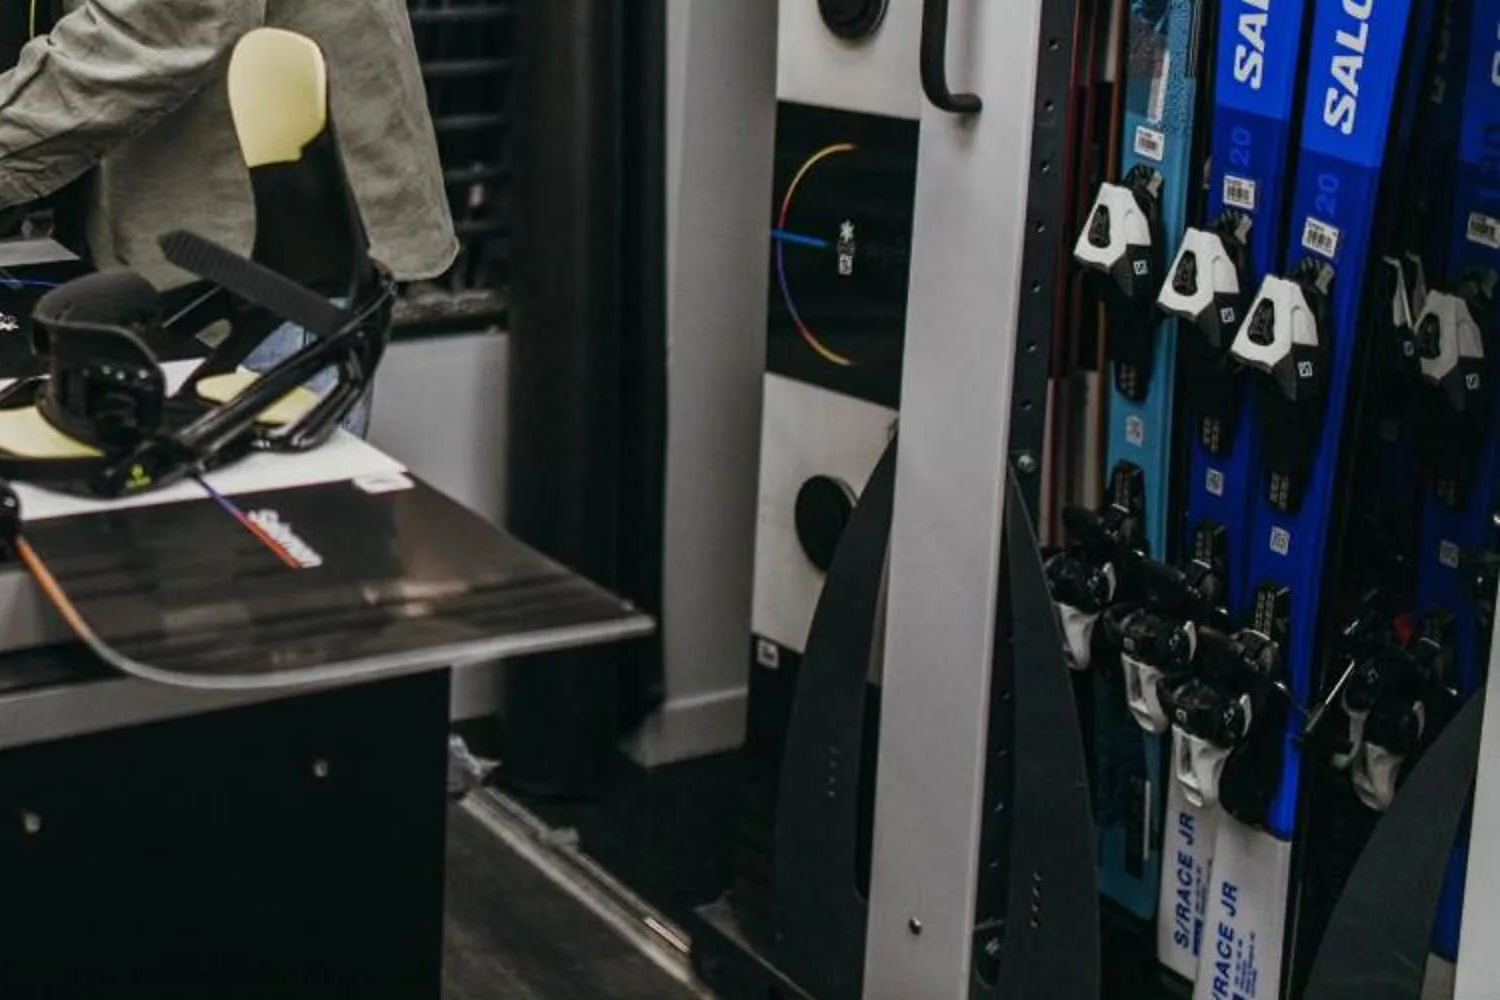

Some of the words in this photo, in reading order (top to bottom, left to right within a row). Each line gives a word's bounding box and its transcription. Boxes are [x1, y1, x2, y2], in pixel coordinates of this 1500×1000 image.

[1177, 811, 1195, 847] JR
[1220, 880, 1238, 918] JR
[1211, 921, 1235, 1000] /RACE
